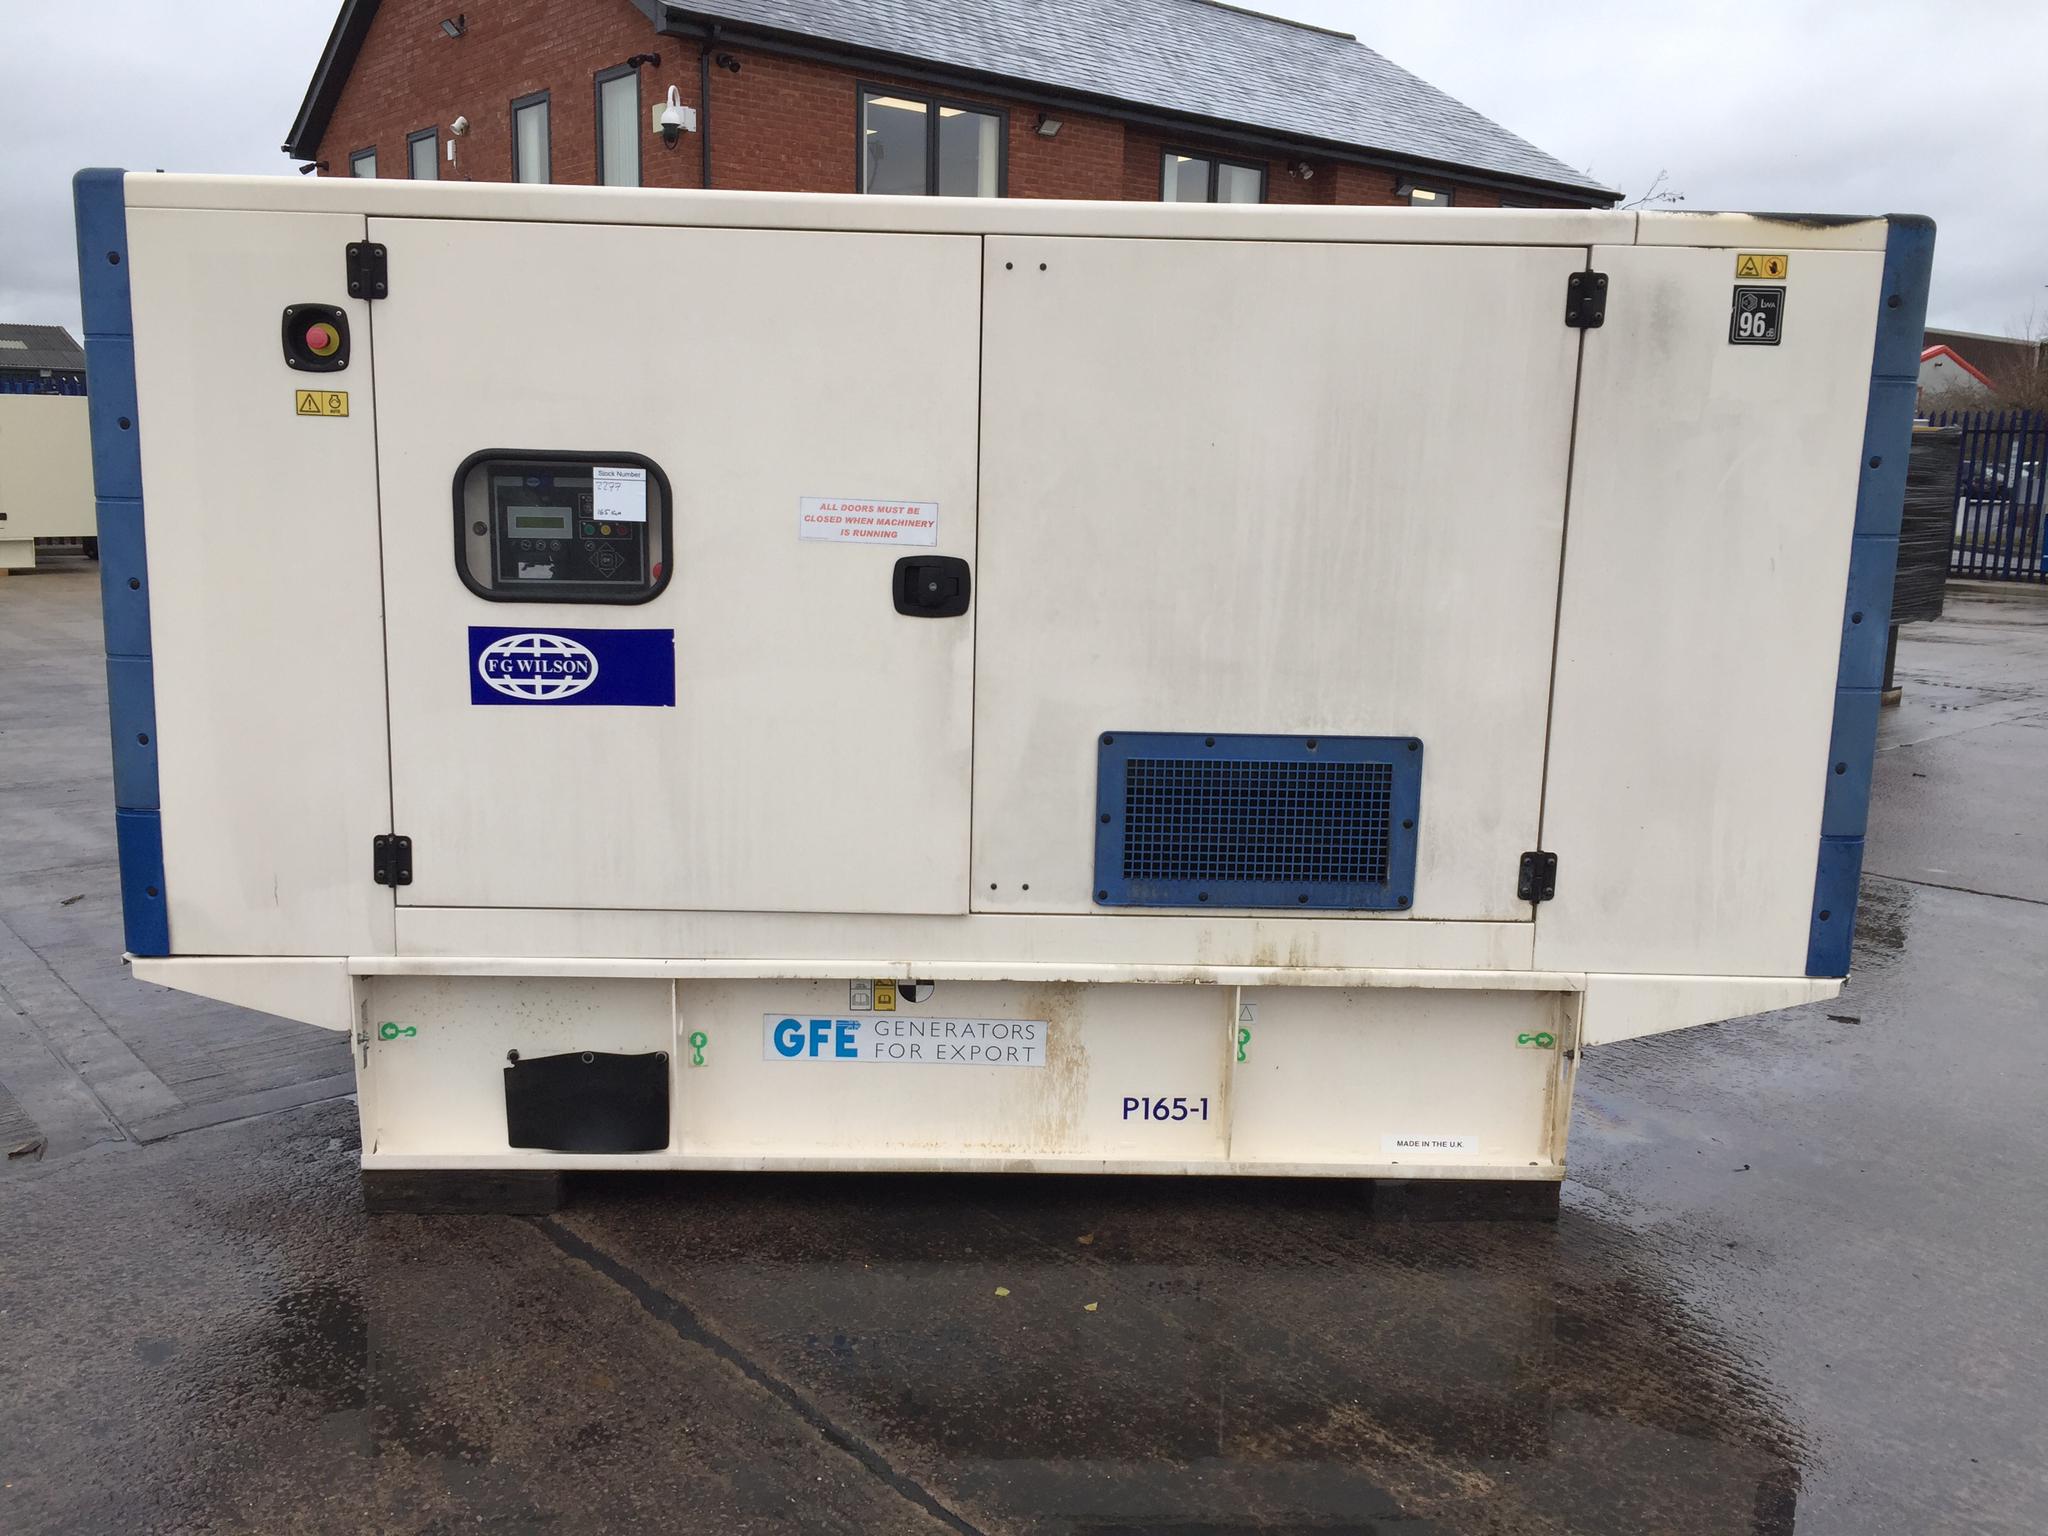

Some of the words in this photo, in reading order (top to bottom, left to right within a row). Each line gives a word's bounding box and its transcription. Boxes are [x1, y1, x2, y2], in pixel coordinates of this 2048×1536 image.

[1739, 311, 1767, 337] 96
[819, 503, 838, 511] ALL
[841, 504, 874, 513] DOORS
[877, 505, 904, 514] MUST
[906, 507, 921, 515] BE
[804, 515, 842, 523] CLOSED
[845, 516, 874, 525] WHEN
[876, 518, 935, 528] MACHINERY
[840, 528, 850, 536] IS
[852, 529, 898, 539] RUNNING
[488, 659, 513, 672] FG
[517, 659, 588, 673] WILSON
[773, 1018, 859, 1059] GFE
[874, 1020, 1036, 1040] GENERATORS
[875, 1042, 922, 1059] FOR
[937, 1044, 1036, 1062] EXPORT
[1123, 1097, 1209, 1121] P165-1
